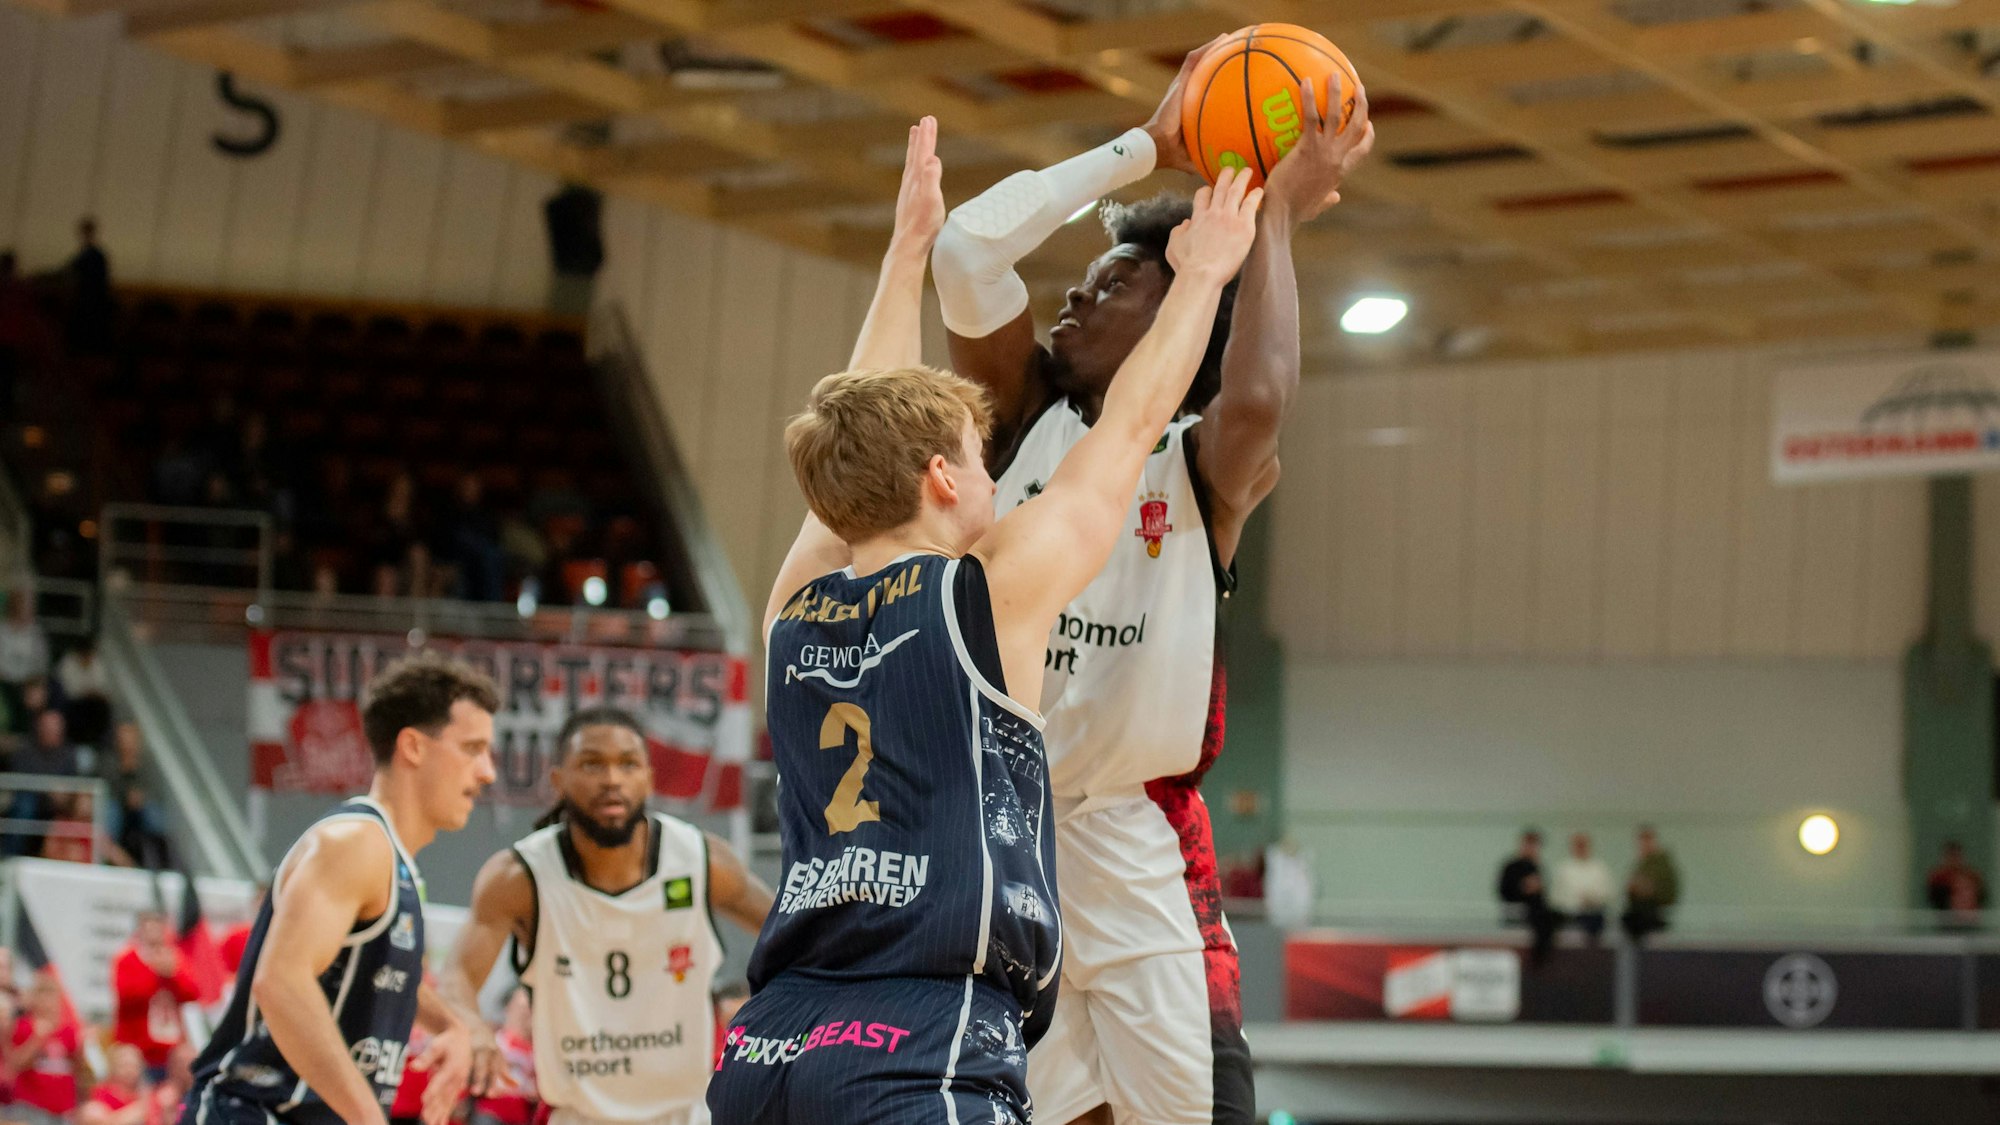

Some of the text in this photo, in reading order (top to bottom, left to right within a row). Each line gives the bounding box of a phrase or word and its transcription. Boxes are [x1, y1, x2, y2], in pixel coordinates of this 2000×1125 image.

[278, 640, 725, 730] SURTERS
[819, 703, 881, 836] 2
[605, 950, 632, 999] 8
[560, 1021, 682, 1052] orthomol
